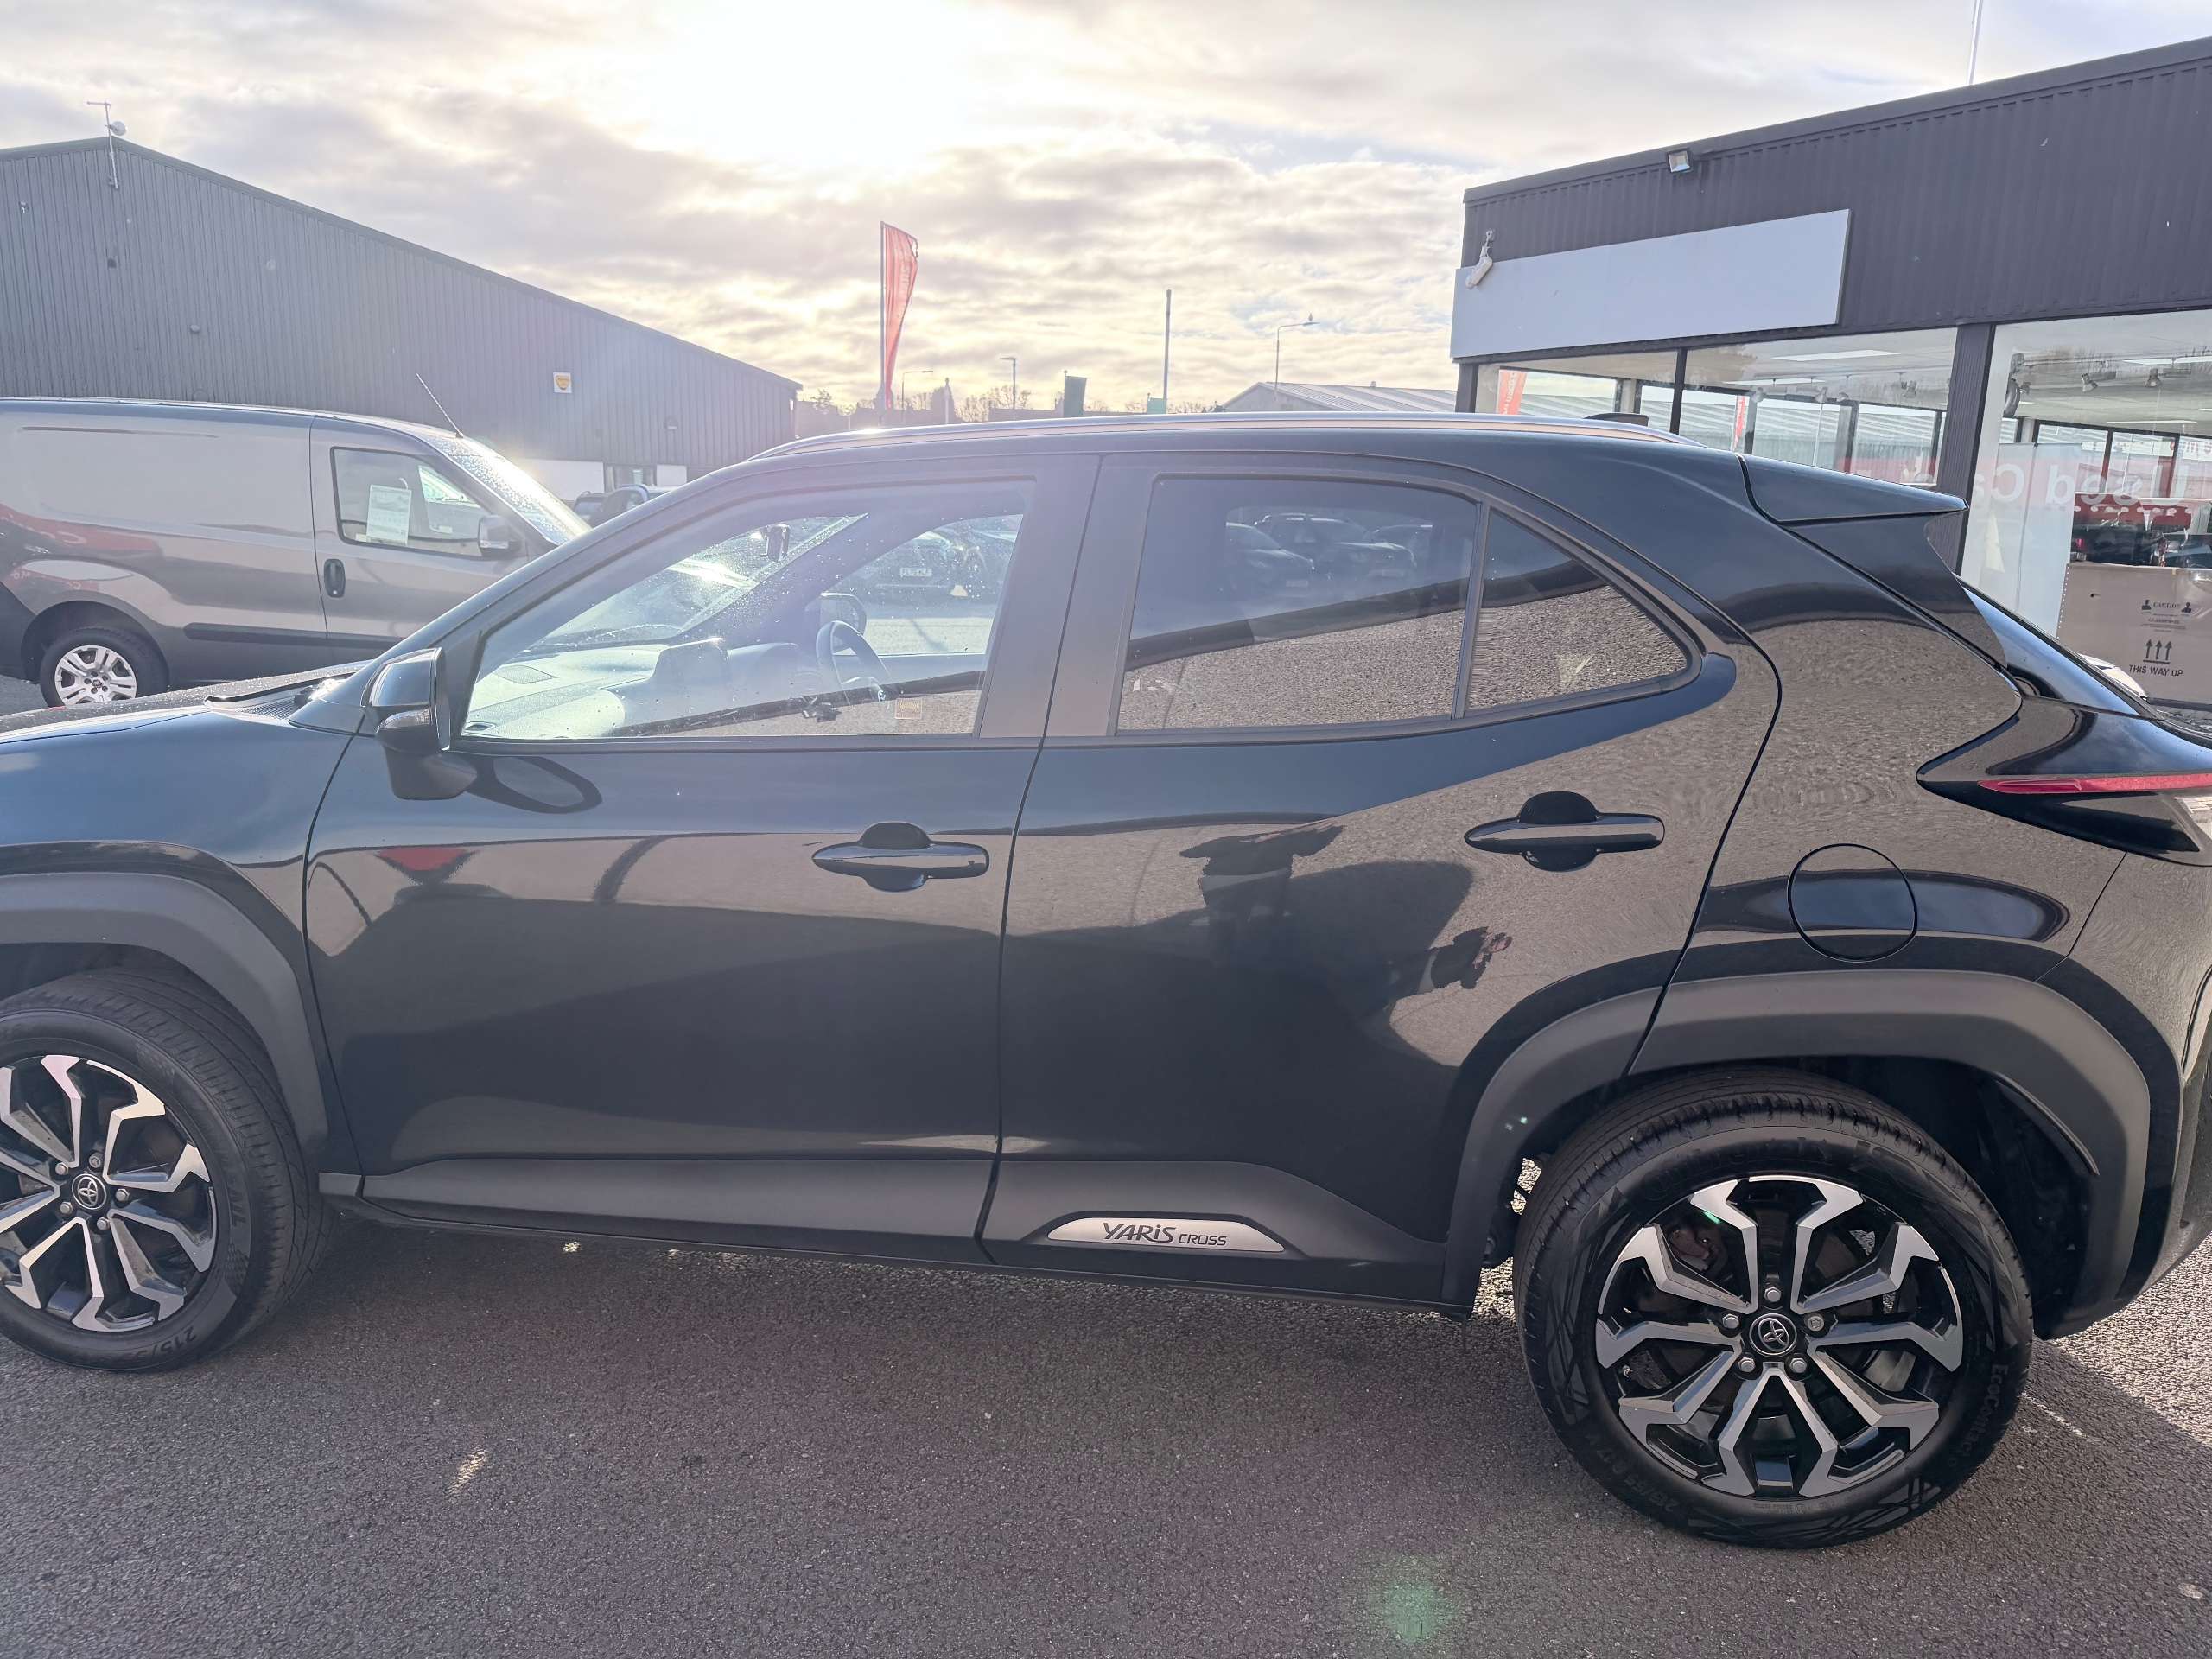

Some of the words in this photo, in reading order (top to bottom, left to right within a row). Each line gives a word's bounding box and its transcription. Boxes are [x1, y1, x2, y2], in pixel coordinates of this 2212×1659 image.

[2128, 664, 2147, 674] THIS
[2150, 667, 2170, 677] WAY
[1178, 1233, 1227, 1246] CROSS
